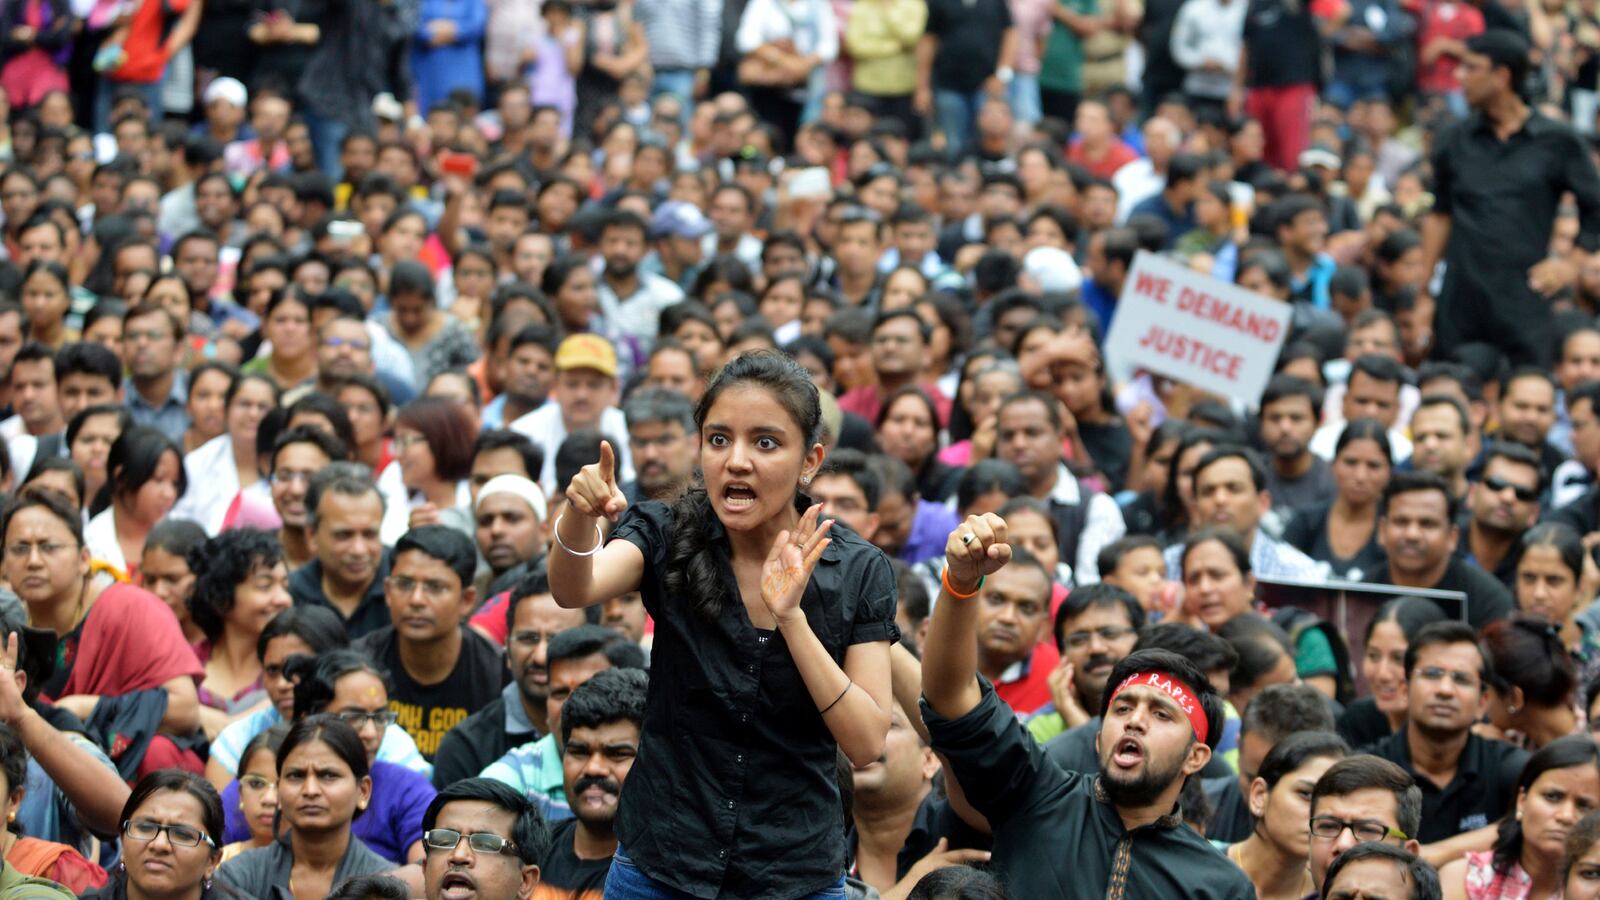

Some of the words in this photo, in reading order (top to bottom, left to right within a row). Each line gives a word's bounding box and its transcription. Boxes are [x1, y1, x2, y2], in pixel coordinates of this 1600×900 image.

[1135, 272, 1172, 303] WE
[1177, 287, 1280, 343] DEMAND
[1139, 325, 1243, 380] JUSTICE
